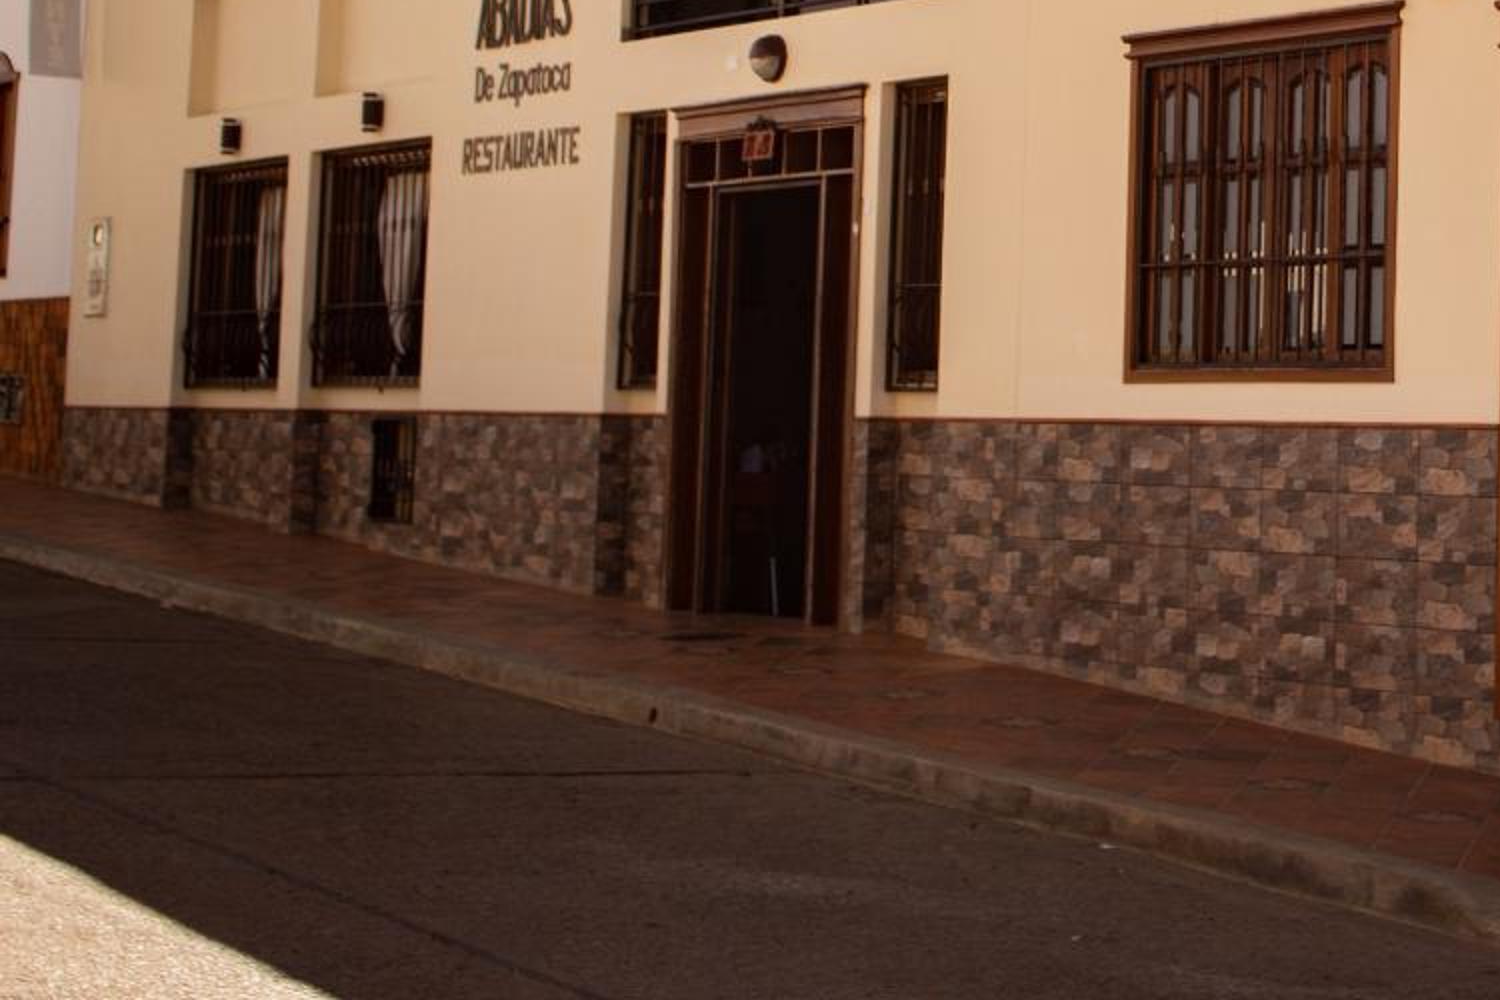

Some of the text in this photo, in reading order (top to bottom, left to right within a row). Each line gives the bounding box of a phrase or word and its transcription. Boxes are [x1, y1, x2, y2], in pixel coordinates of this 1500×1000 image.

[474, 61, 572, 108] De Zapatoca
[461, 126, 581, 176] RESTAURANTE
